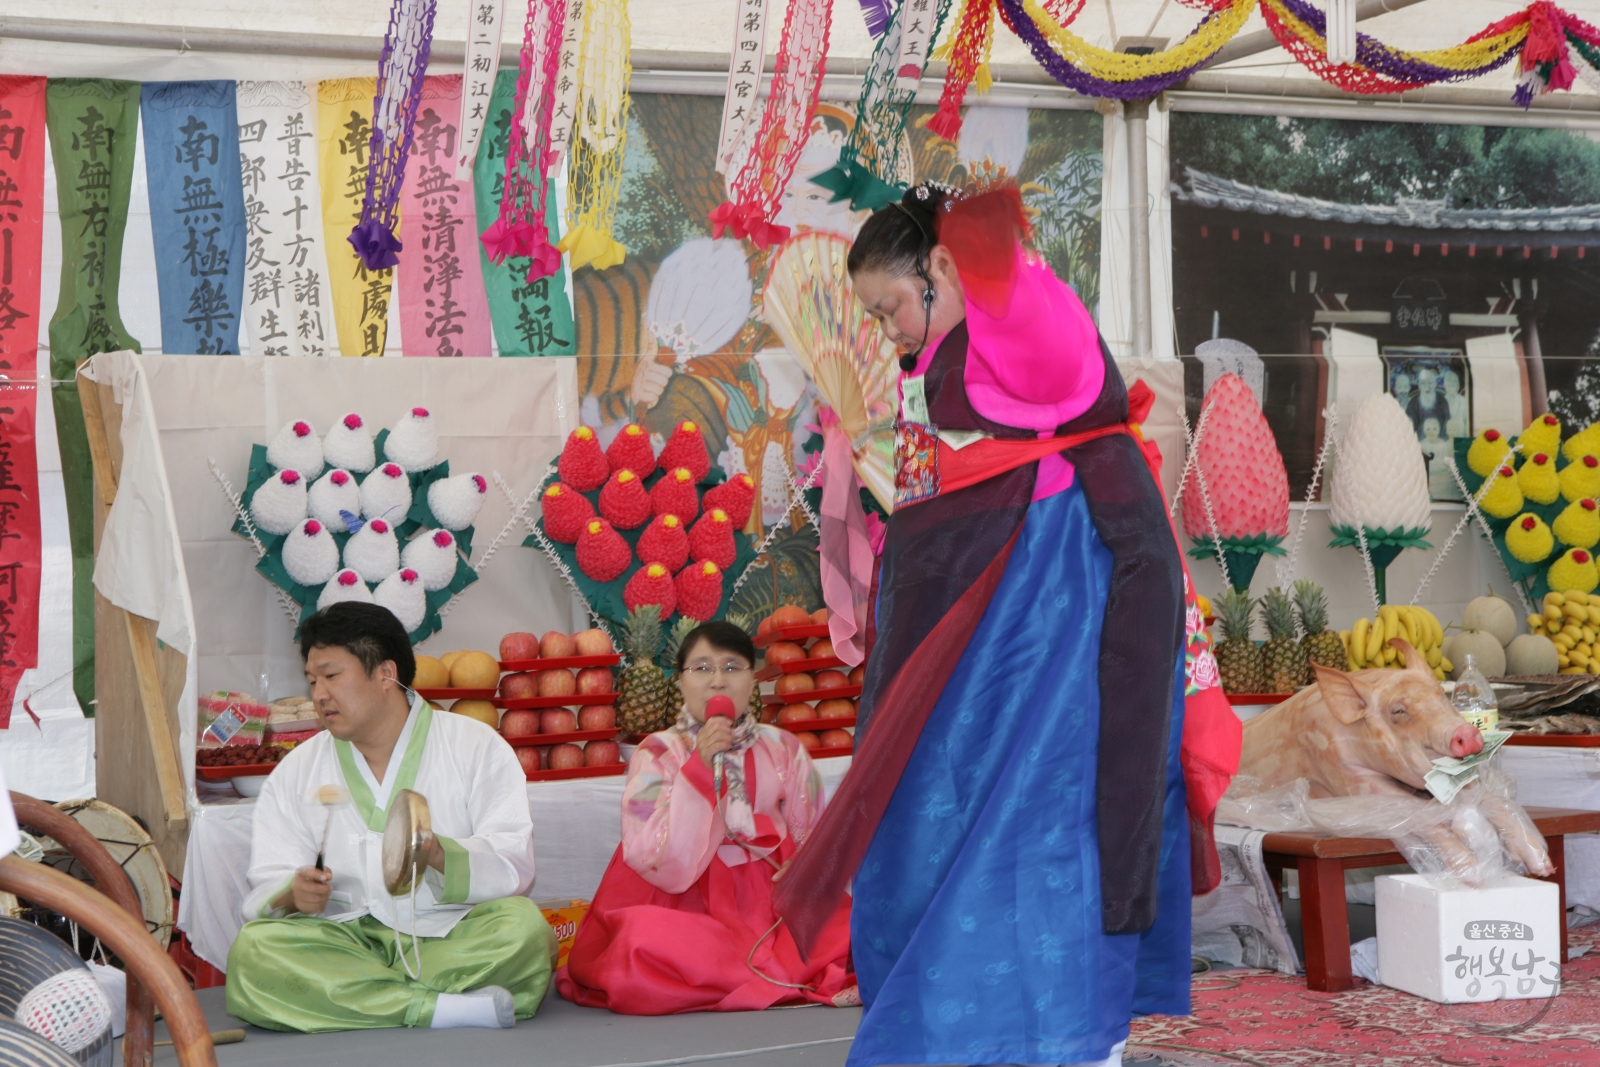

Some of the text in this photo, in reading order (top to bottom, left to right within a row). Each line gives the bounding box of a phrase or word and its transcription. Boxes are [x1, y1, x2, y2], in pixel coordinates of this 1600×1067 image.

[551, 1, 583, 143] 第三宋帝大王
[728, 0, 762, 142] 第四五官大
